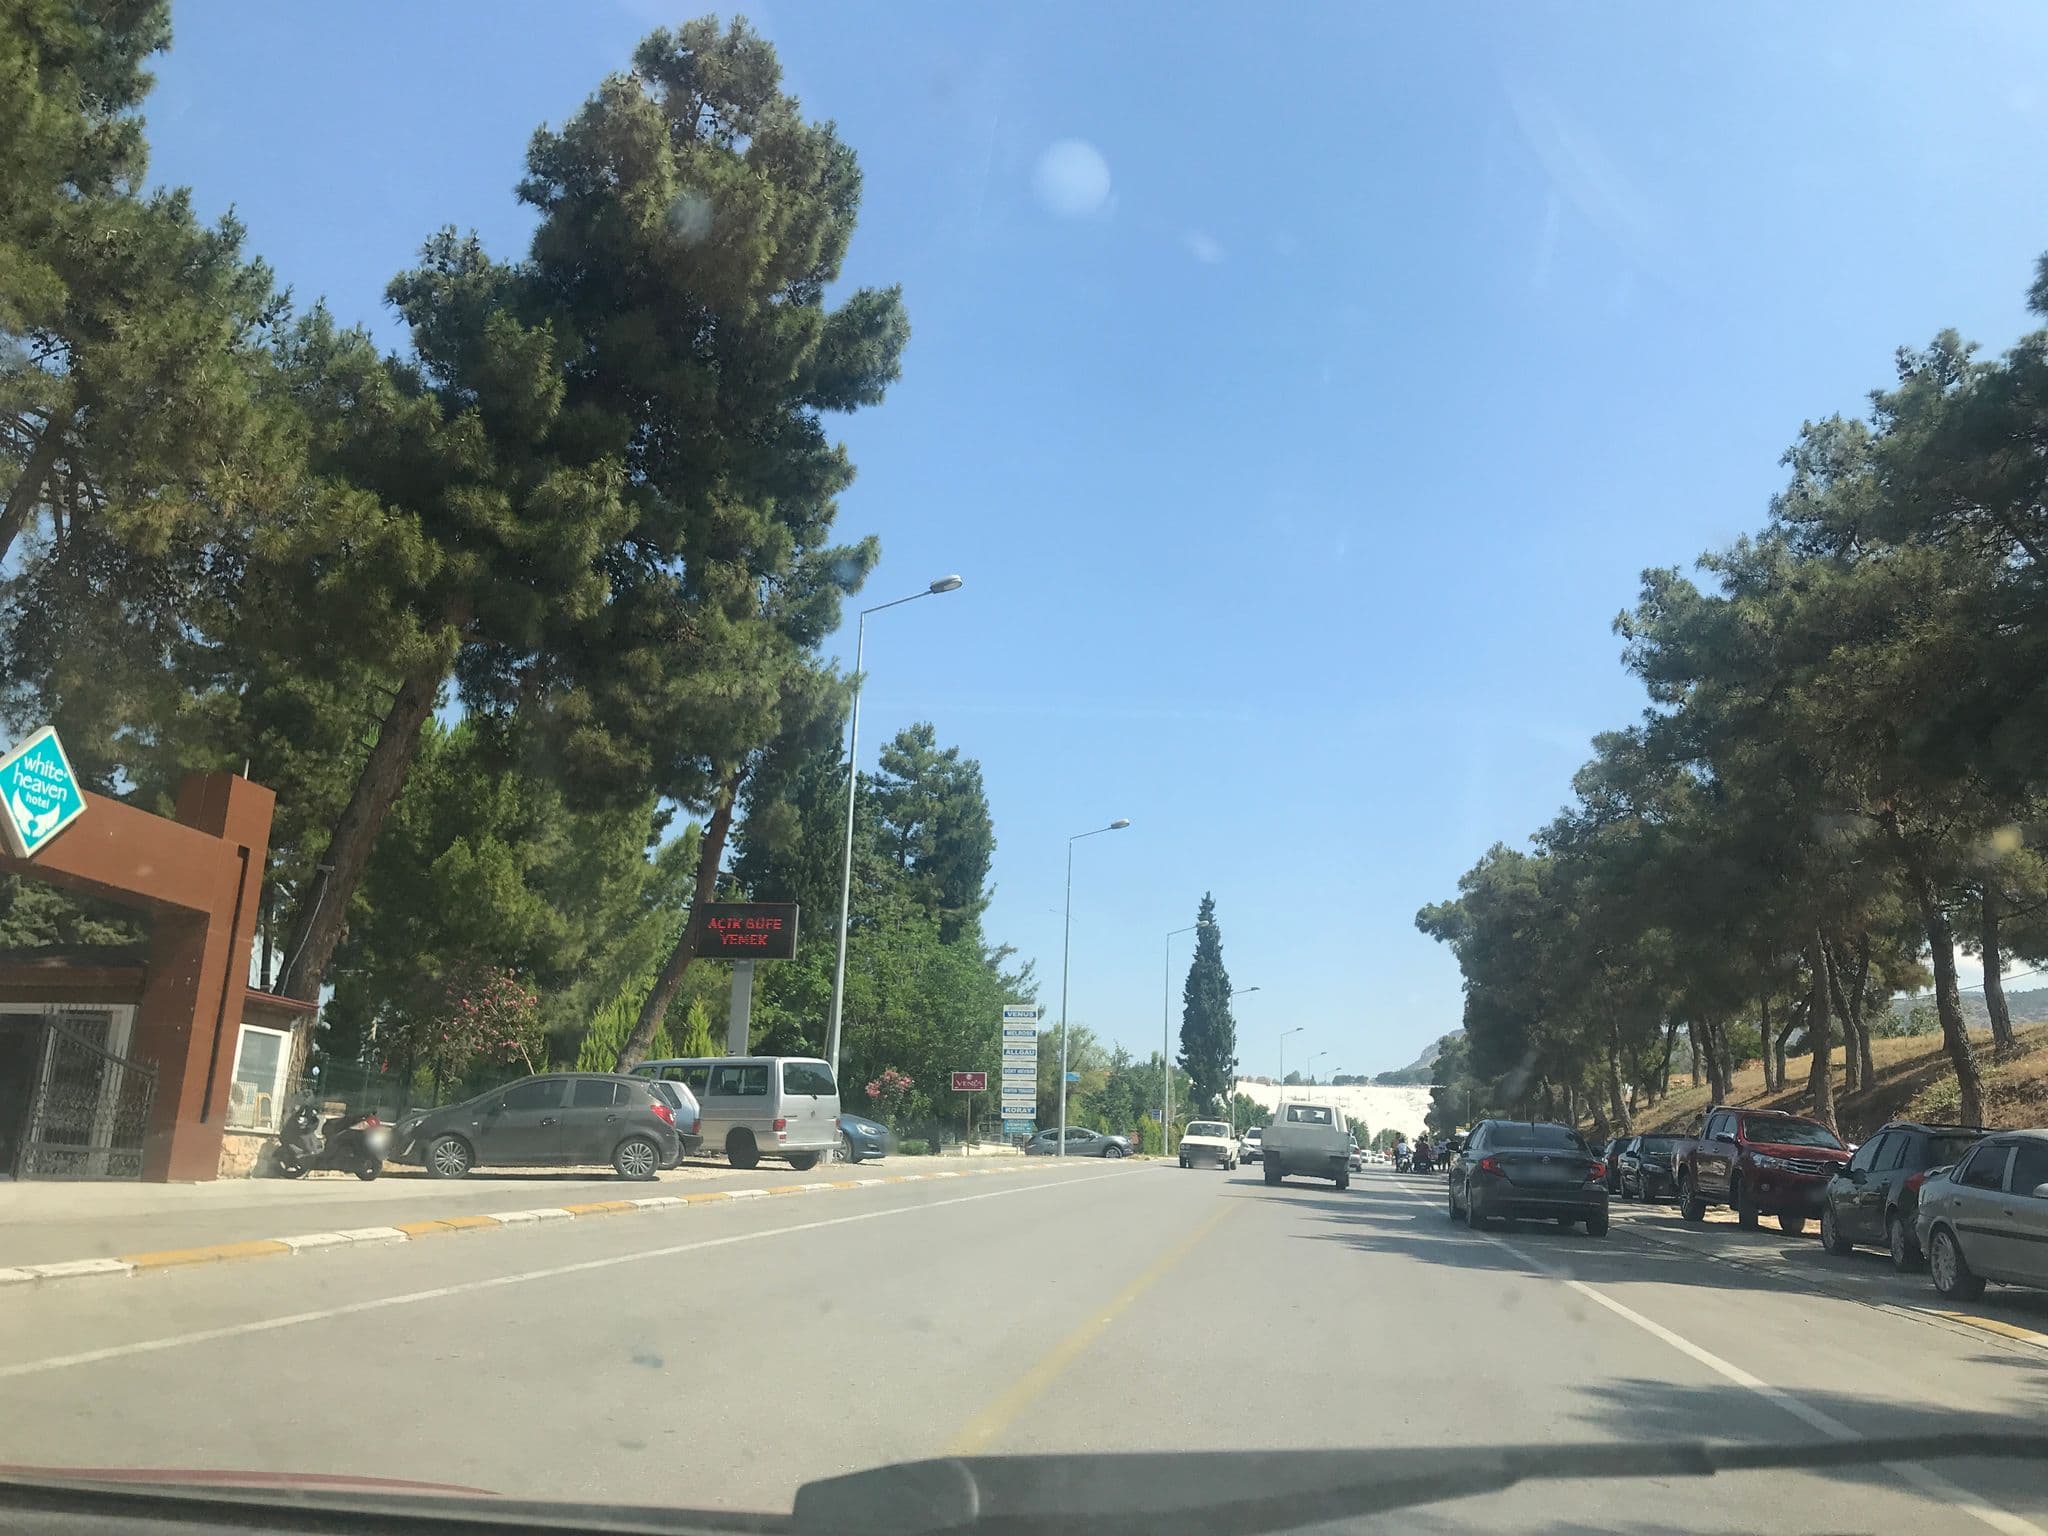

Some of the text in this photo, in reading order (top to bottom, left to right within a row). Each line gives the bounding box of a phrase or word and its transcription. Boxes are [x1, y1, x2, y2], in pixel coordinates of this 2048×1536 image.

[24, 752, 64, 782] white
[12, 762, 68, 802] heaven
[25, 791, 51, 809] hotel
[721, 934, 768, 945] YEMEK
